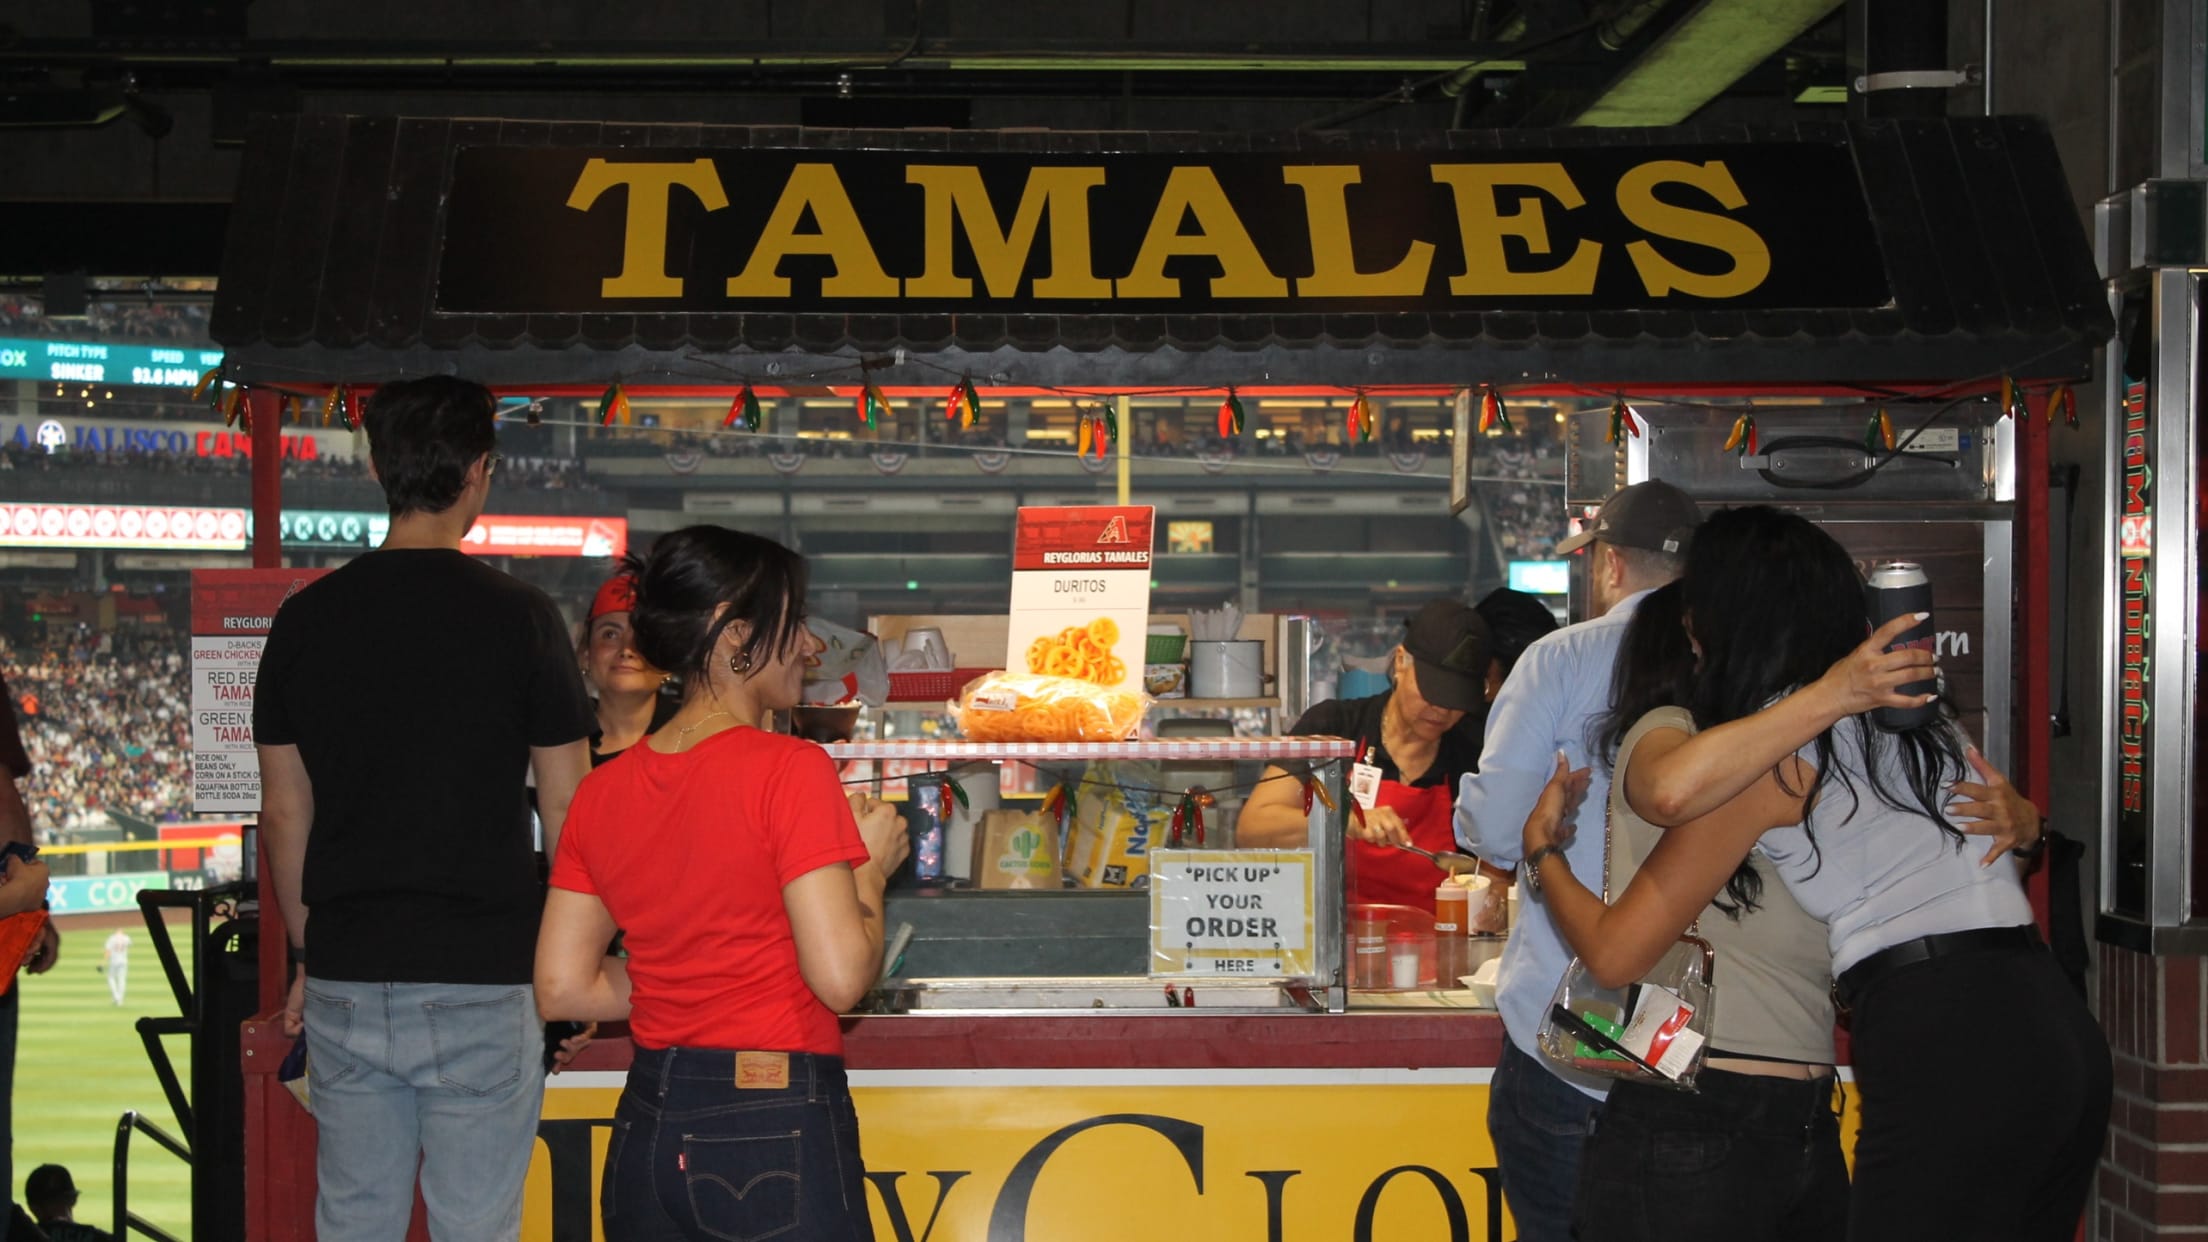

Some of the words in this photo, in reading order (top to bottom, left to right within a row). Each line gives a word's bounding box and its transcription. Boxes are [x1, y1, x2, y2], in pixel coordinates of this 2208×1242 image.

[566, 158, 1771, 298] TAMALES
[47, 344, 80, 358] PITCH
[81, 346, 108, 360] TYPE
[151, 349, 184, 364] SPEED
[51, 363, 104, 381] SINKER
[132, 367, 164, 385] 93.6
[165, 369, 198, 386] MPH
[72, 425, 188, 452] JALISCO
[1043, 551, 1103, 564] REYGLORIAS
[1104, 551, 1149, 563] TAMALES
[1054, 579, 1106, 593] DURITOS
[223, 616, 272, 629] REYGLORI
[227, 641, 262, 649] D-BACKS
[193, 650, 222, 660] GREEN
[224, 650, 261, 660] CHICKEN
[208, 672, 235, 684] RED
[239, 672, 256, 685] BE
[213, 685, 257, 700] TAMA
[199, 712, 246, 725] GREEN
[213, 726, 253, 742] TAMA
[195, 754, 210, 762] RICE
[211, 754, 228, 762] ONLY
[195, 771, 214, 779] CORN
[215, 771, 226, 779] ON
[226, 771, 232, 779] A
[233, 771, 252, 779] STICK
[195, 783, 229, 791] AQUAFINA
[230, 783, 260, 791] BOTTLED
[195, 792, 221, 800] BOTTLE
[222, 792, 241, 800] SODA
[1193, 867, 1238, 882] PICK
[1244, 867, 1271, 882] UP
[88, 881, 147, 905] COX
[1206, 894, 1263, 909] YOUR
[1186, 917, 1279, 937] ORDER
[1215, 959, 1255, 972] HERE
